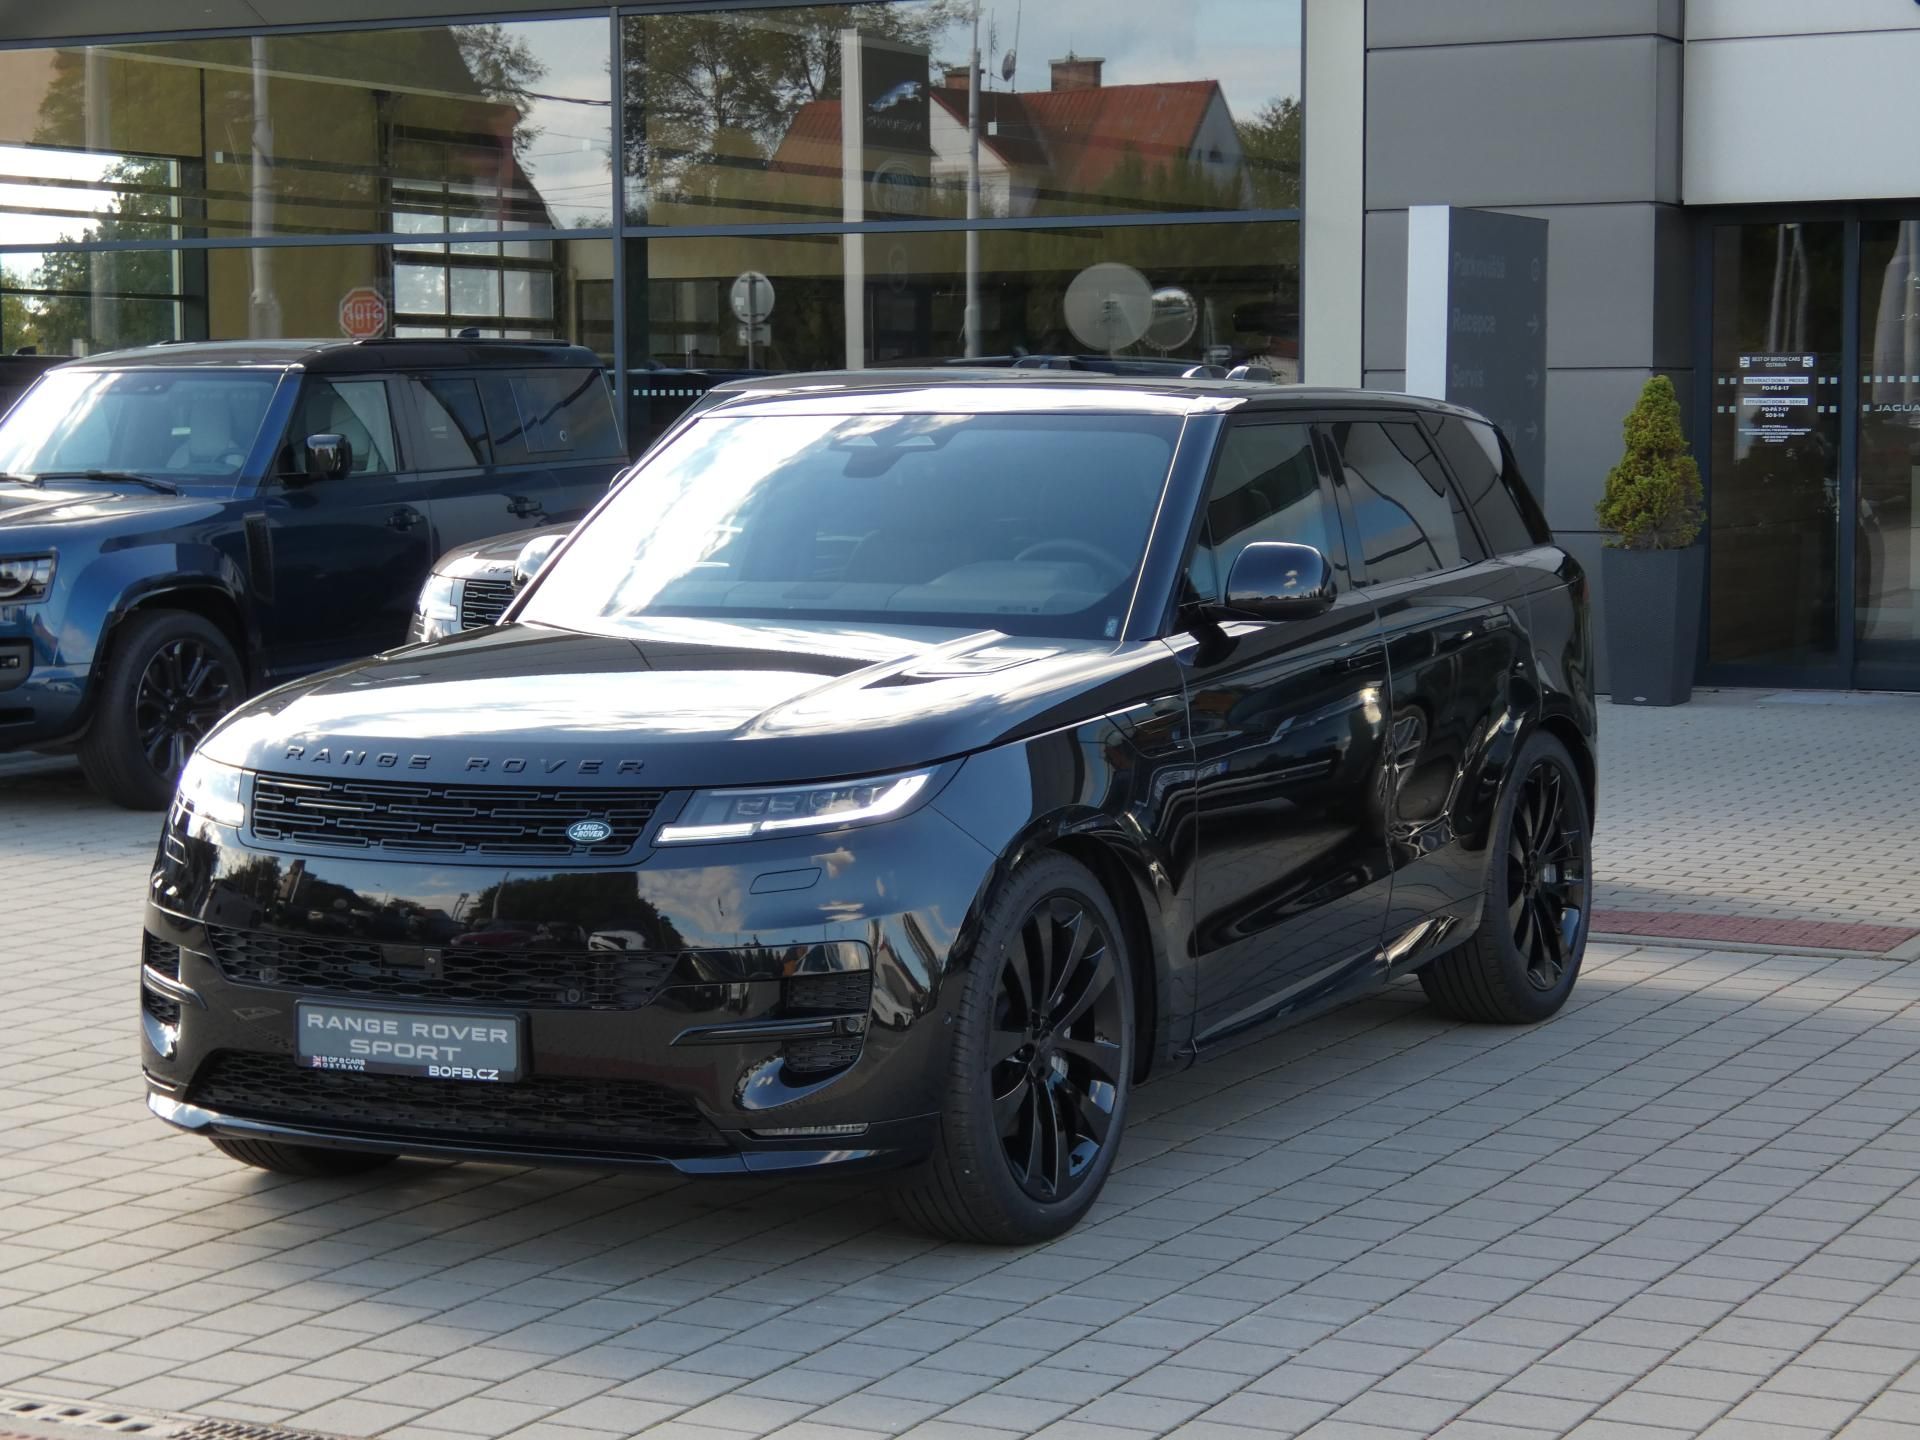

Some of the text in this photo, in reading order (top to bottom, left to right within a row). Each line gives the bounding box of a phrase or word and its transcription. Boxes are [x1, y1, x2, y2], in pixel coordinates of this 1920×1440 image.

[284, 745, 645, 775] RANGE ROVER
[576, 830, 604, 838] ROVER
[307, 1013, 508, 1044] RANGE ROVER
[350, 1038, 461, 1062] SPORT
[322, 1062, 365, 1071] OSTRAVA
[345, 1058, 366, 1066] CARS
[429, 1065, 499, 1081] BOFB.CZ
